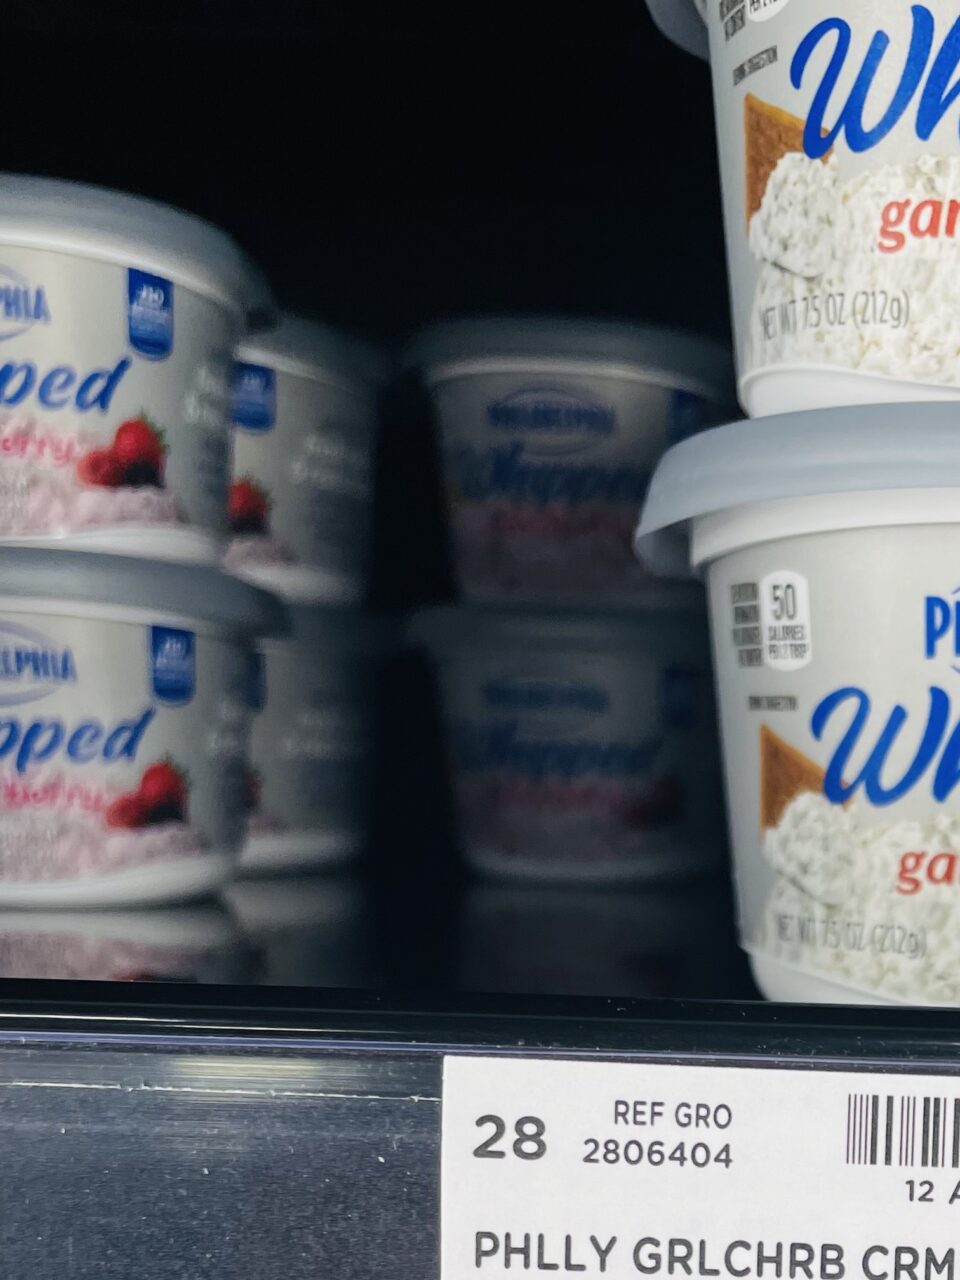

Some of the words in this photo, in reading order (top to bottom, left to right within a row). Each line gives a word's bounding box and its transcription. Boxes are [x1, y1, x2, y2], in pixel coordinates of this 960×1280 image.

[825, 292, 847, 326] OZ
[852, 289, 911, 331] (212g)
[772, 583, 797, 621] 50
[614, 1099, 665, 1126] REF
[674, 1102, 732, 1130] GRO
[472, 1114, 547, 1161] 28
[582, 1138, 733, 1169] 2806404
[905, 1179, 934, 1202] 12
[475, 1231, 617, 1273] PHLLY
[632, 1236, 845, 1280] GRLCHRB
